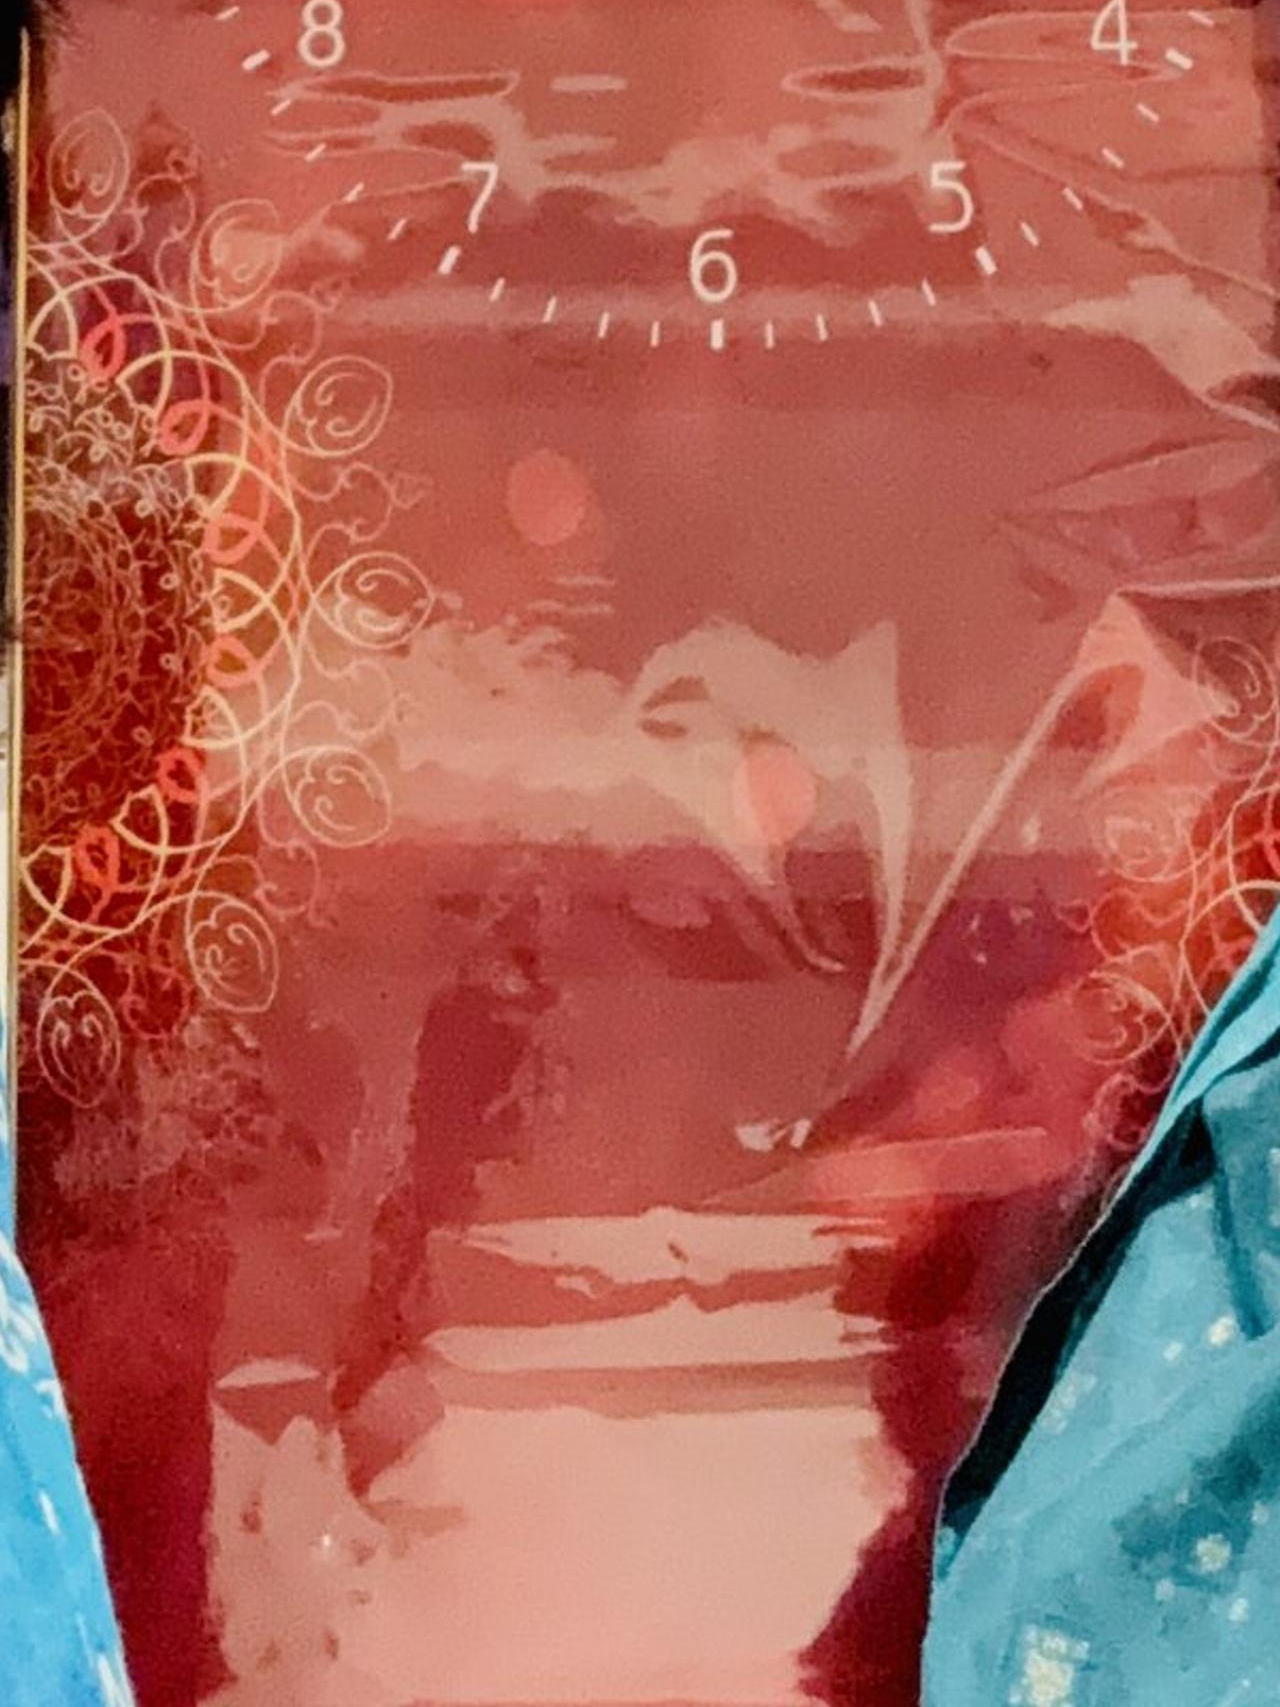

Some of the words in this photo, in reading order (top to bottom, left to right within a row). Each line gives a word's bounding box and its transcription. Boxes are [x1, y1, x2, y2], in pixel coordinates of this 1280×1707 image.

[461, 165, 500, 233] 7
[929, 163, 973, 232] 5
[689, 230, 738, 301] 6
